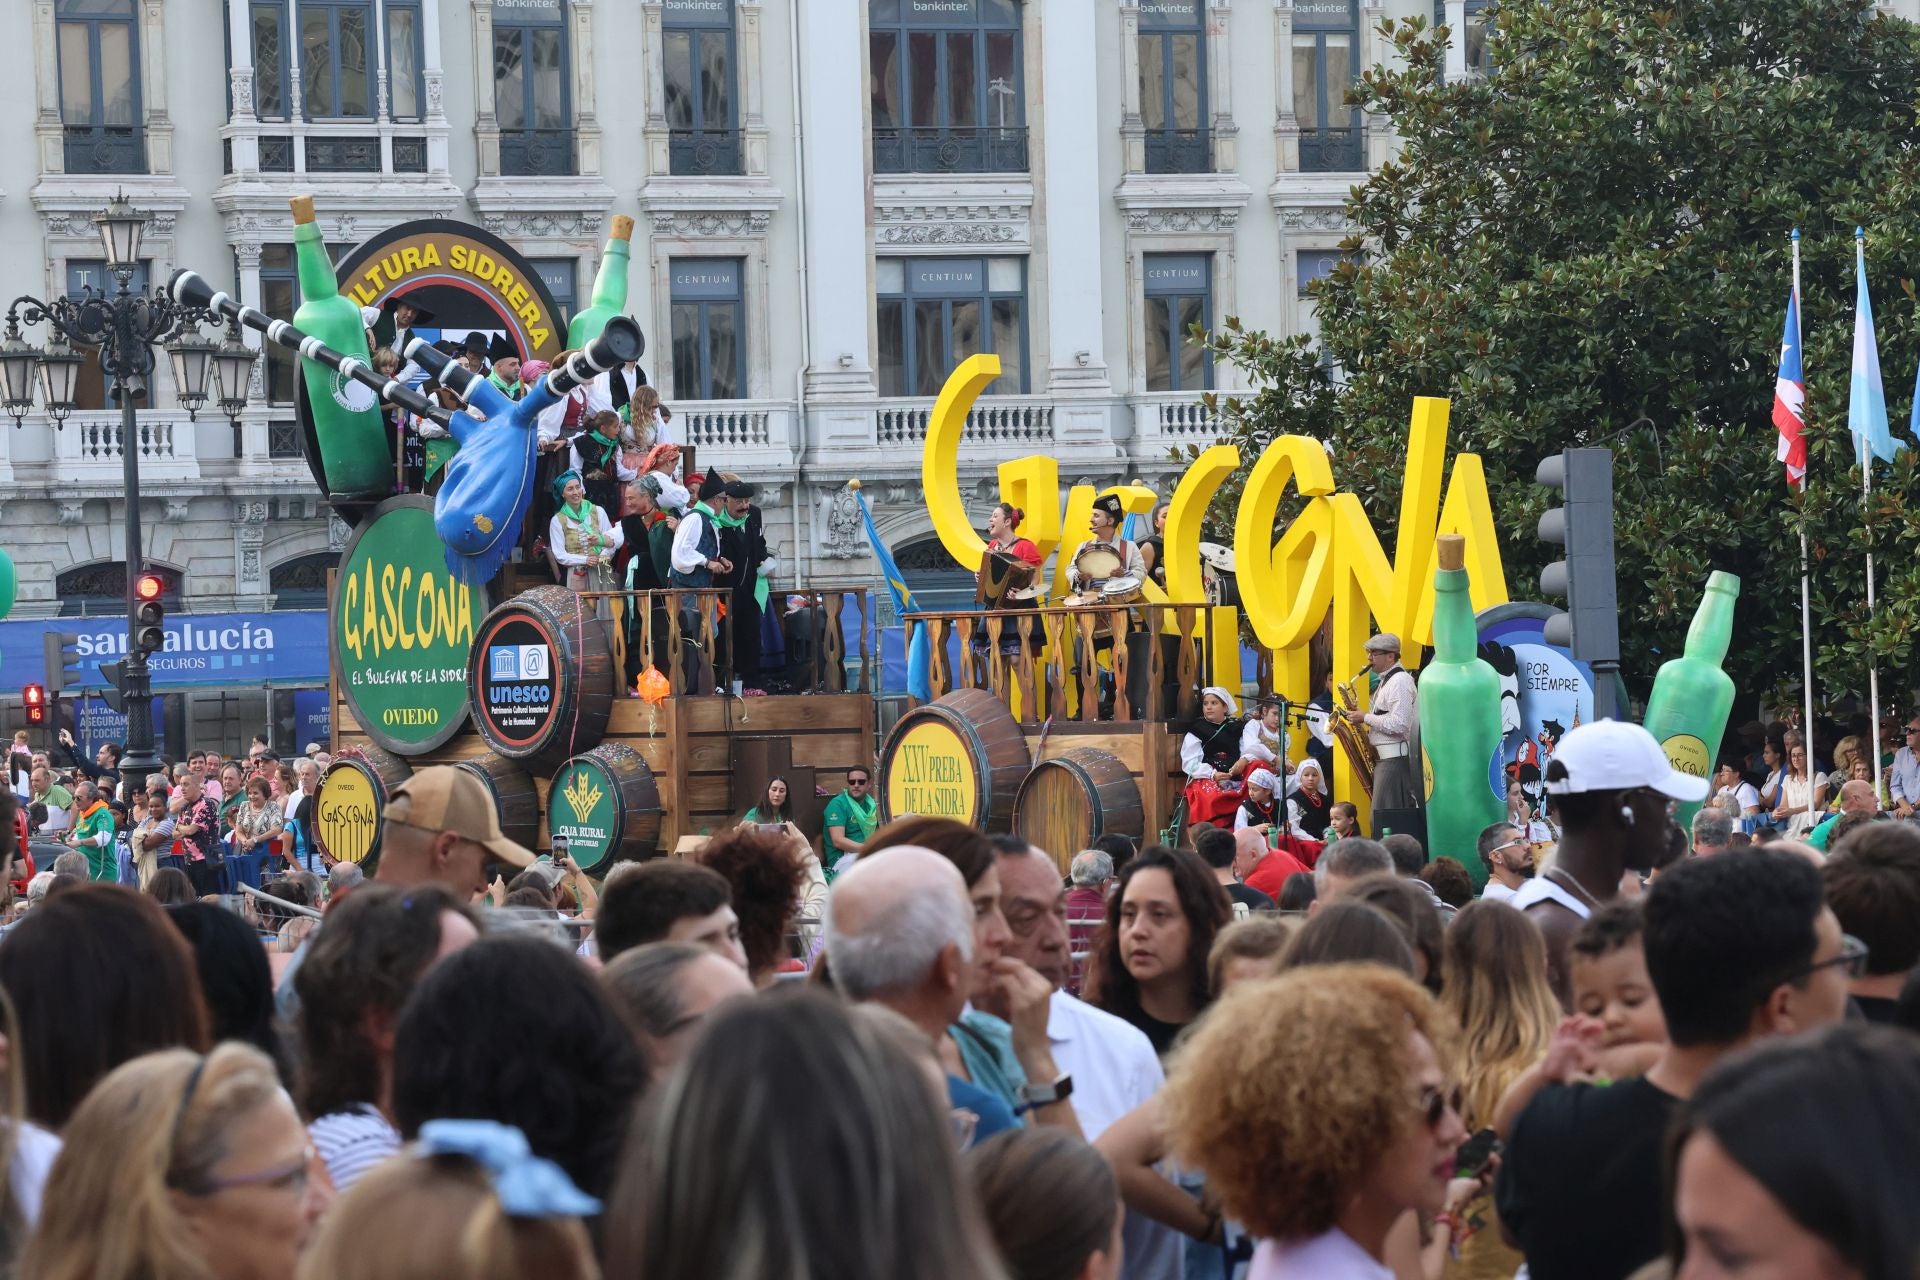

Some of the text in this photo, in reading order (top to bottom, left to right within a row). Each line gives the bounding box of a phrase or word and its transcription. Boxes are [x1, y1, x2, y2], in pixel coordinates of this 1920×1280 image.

[677, 275, 730, 284] CENTIUM
[921, 272, 973, 281] CENTIUM
[1148, 269, 1199, 278] CENTIUM
[347, 243, 550, 350] LTURA SIDRERA
[344, 556, 474, 660] GASCONA
[146, 657, 206, 671] SEGUROS
[1526, 662, 1550, 676] POR
[352, 670, 364, 685] EL
[365, 667, 408, 685] BULEVAR
[410, 668, 423, 683] DE
[425, 668, 438, 684] LA
[1526, 677, 1579, 692] SIEMPRE
[490, 685, 550, 703] unesco
[31, 708, 41, 719] 16
[383, 708, 439, 725] OVIEDO
[903, 745, 963, 783] XXV PREBA
[904, 787, 966, 815] DE LA SIDRA
[321, 800, 374, 828] GASCONA
[559, 825, 607, 839] CAJA RURAL
